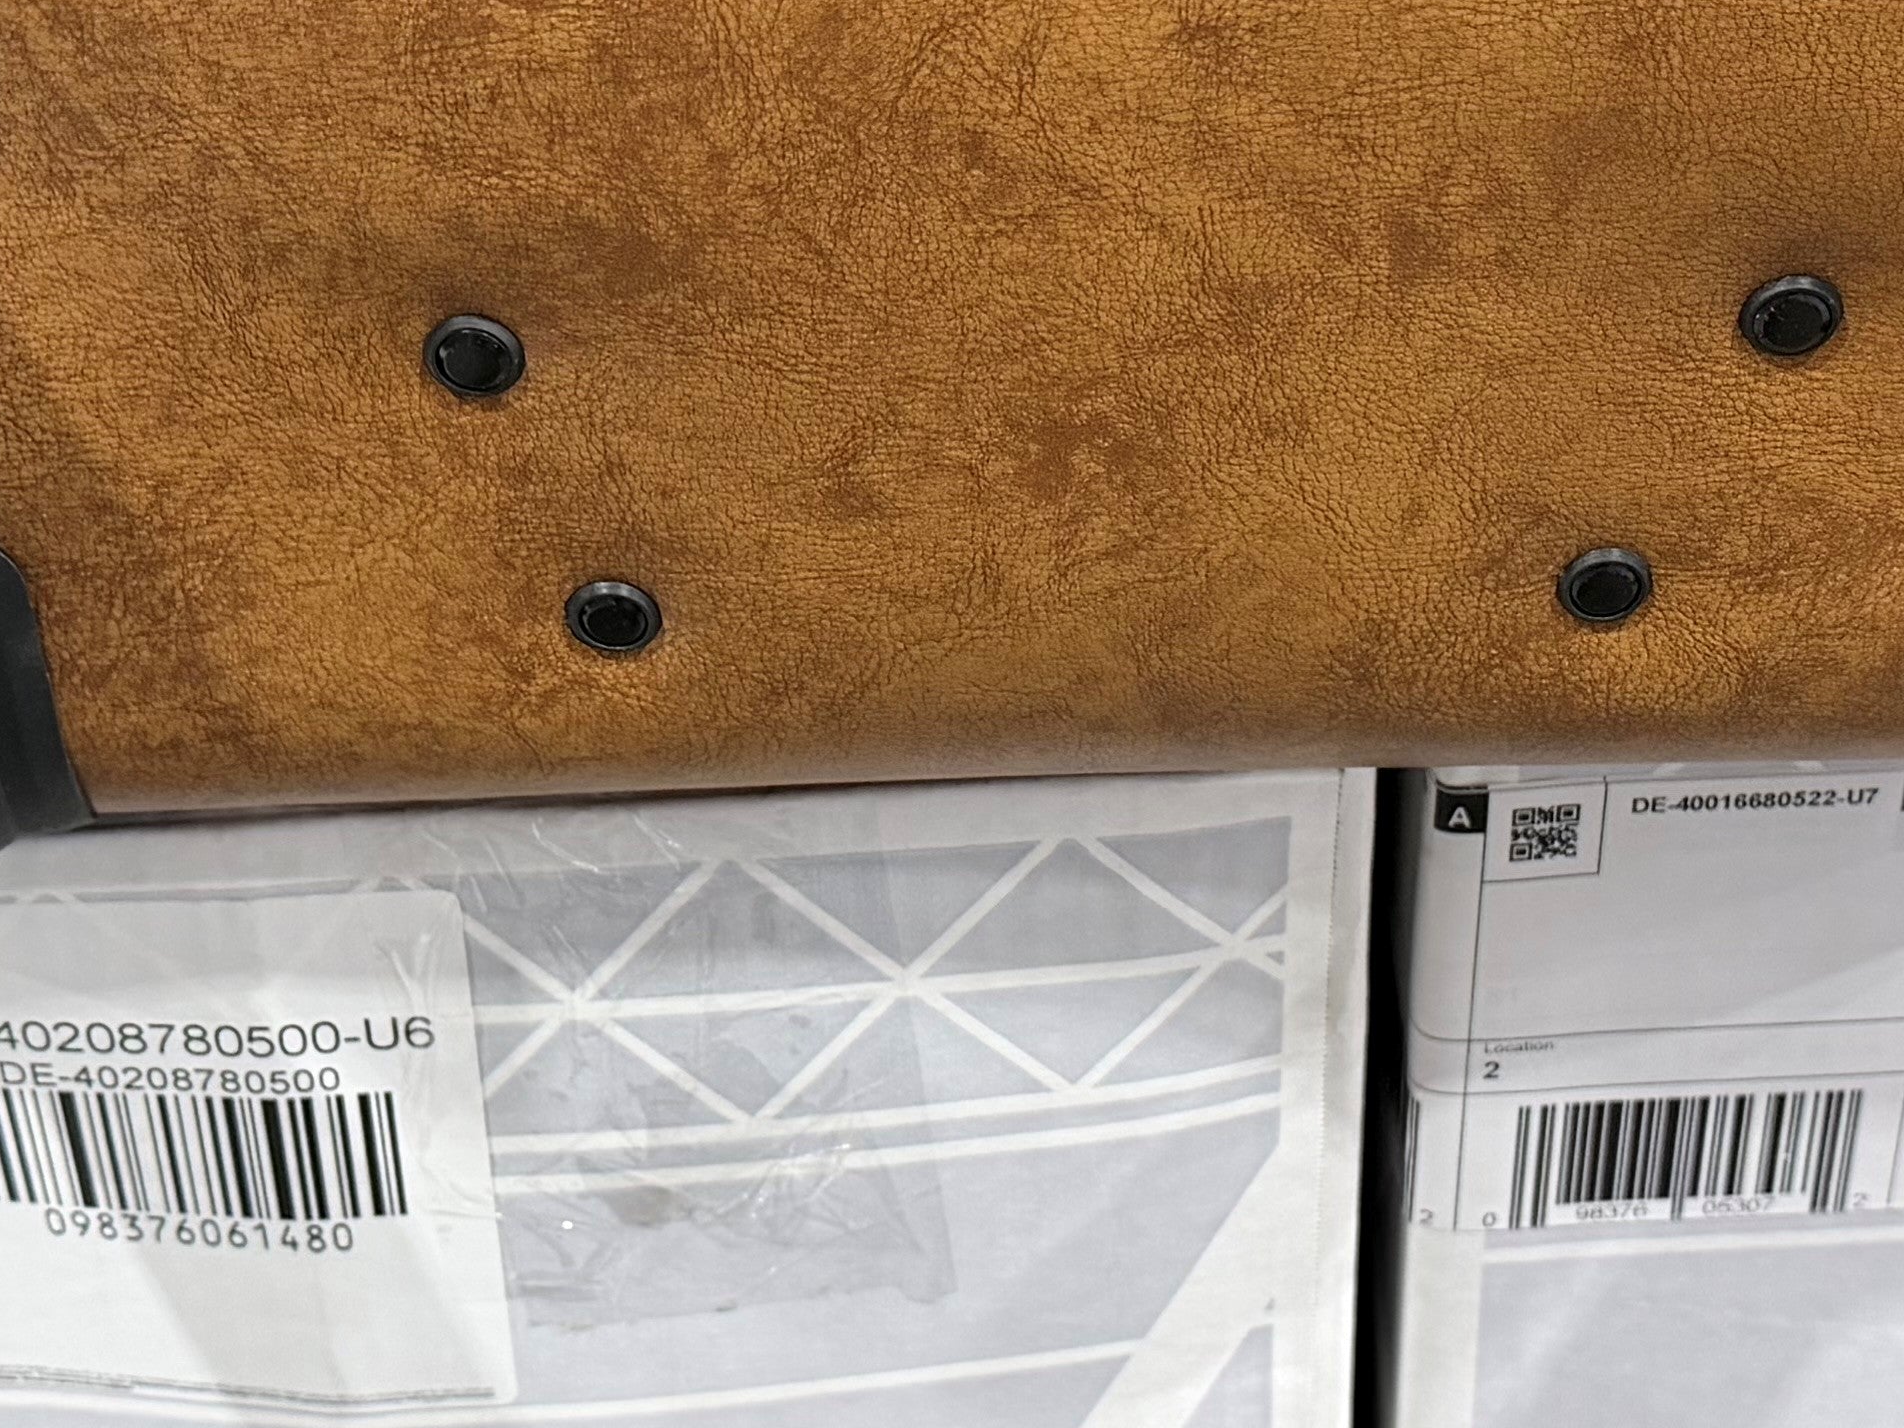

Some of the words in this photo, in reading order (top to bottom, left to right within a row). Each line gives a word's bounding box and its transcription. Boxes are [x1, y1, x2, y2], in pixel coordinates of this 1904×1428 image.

[1447, 806, 1473, 829] A
[1631, 787, 1880, 815] DE-40016680522-U7
[1483, 1060, 1500, 1080] 2
[1419, 1209, 1434, 1227] 2
[1482, 1212, 1496, 1227] 0
[1575, 1202, 1649, 1220] 98376
[44, 1207, 354, 1252] 098376061480
